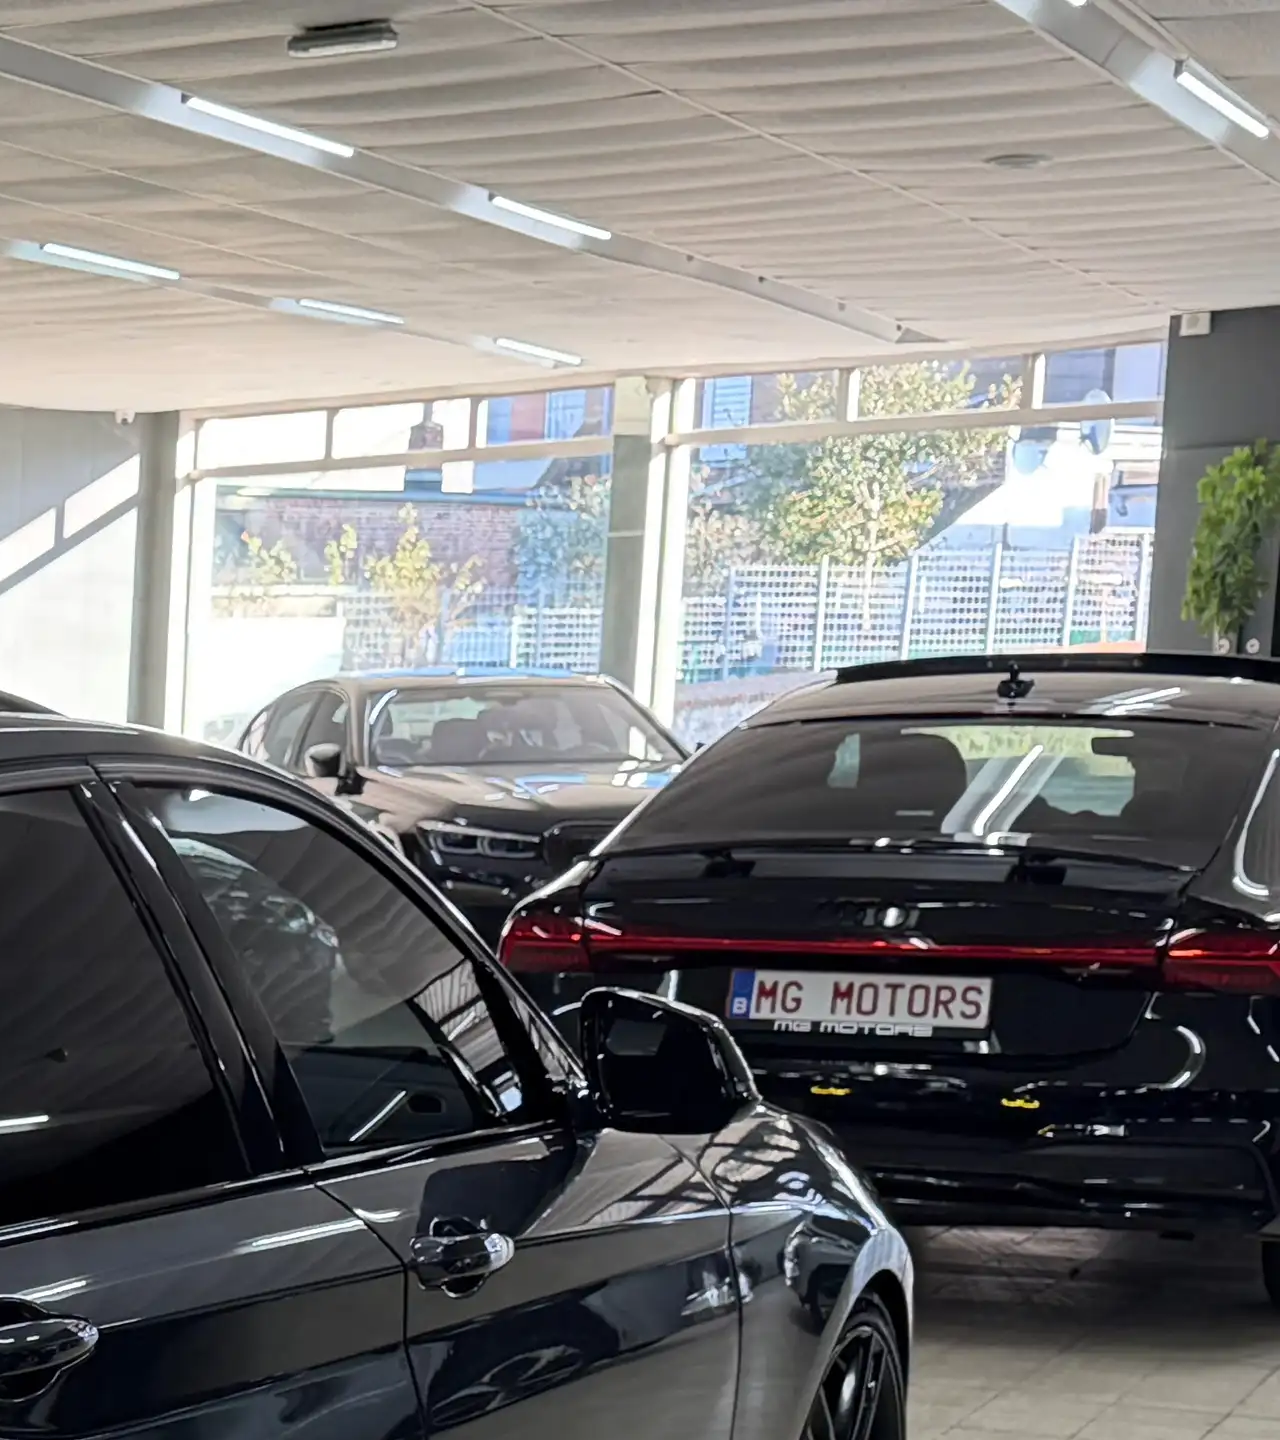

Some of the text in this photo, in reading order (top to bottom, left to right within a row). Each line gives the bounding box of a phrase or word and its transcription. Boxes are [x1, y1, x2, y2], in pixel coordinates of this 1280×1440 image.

[732, 997, 747, 1015] B
[755, 980, 983, 1020] MG MOTORS
